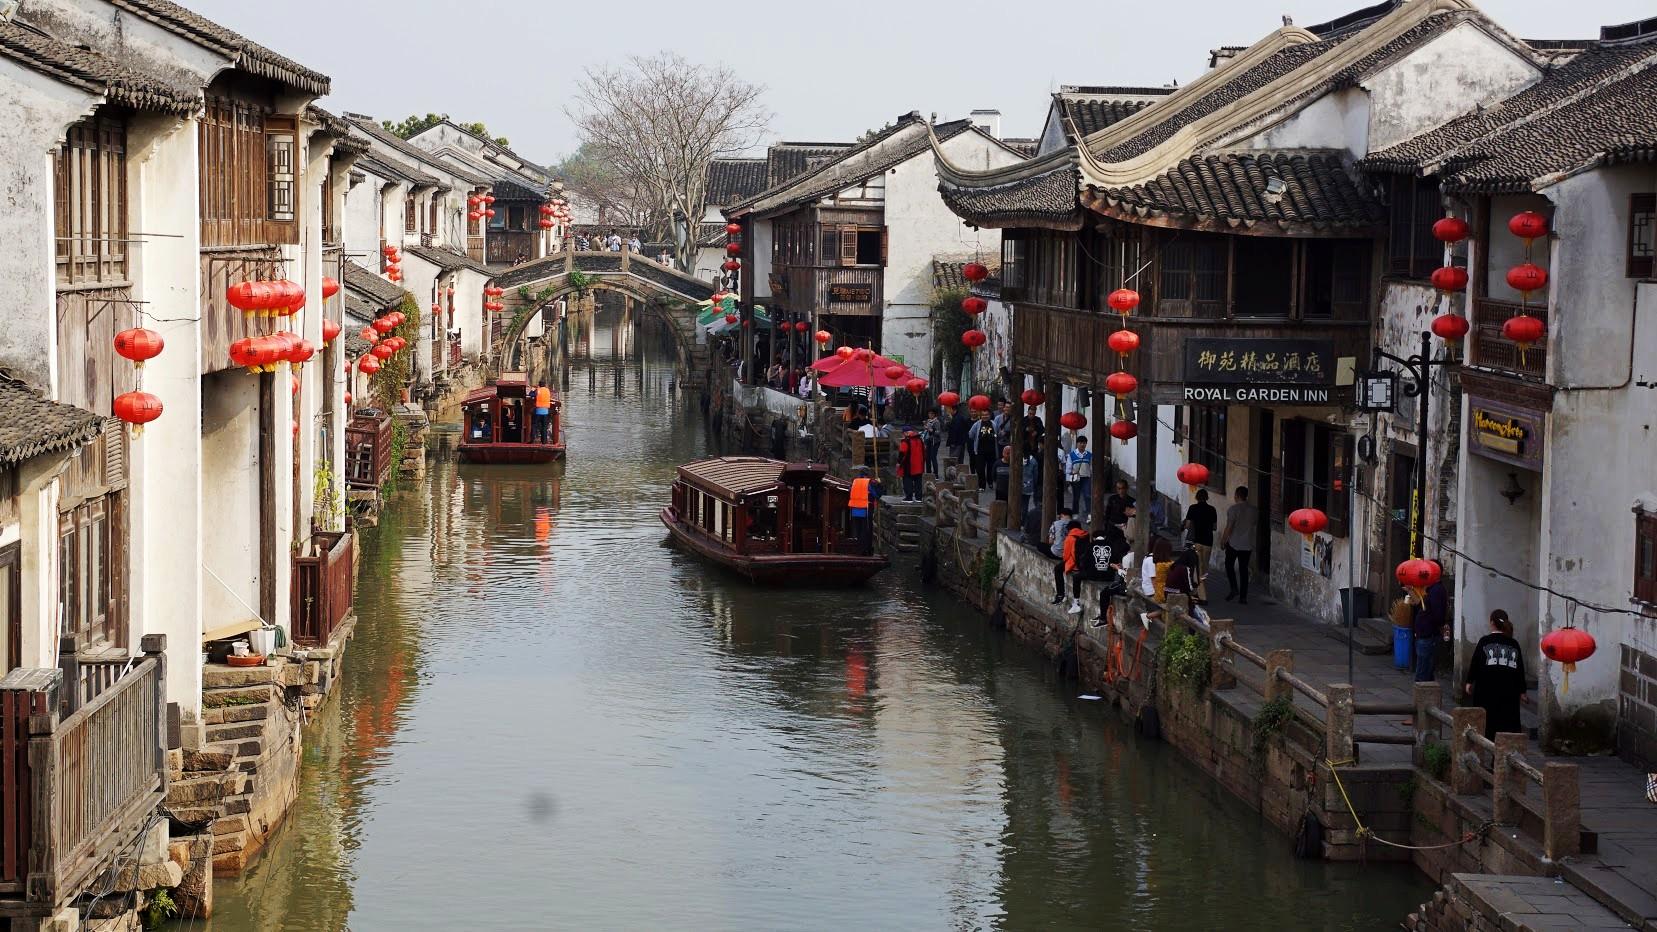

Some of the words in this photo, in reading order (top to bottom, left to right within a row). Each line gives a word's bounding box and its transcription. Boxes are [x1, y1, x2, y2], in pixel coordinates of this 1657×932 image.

[1198, 350, 1321, 372] 御苑精品酒店
[1184, 387, 1231, 400] ROYAL
[1236, 388, 1299, 401] GARDEN
[1304, 389, 1328, 402] INN
